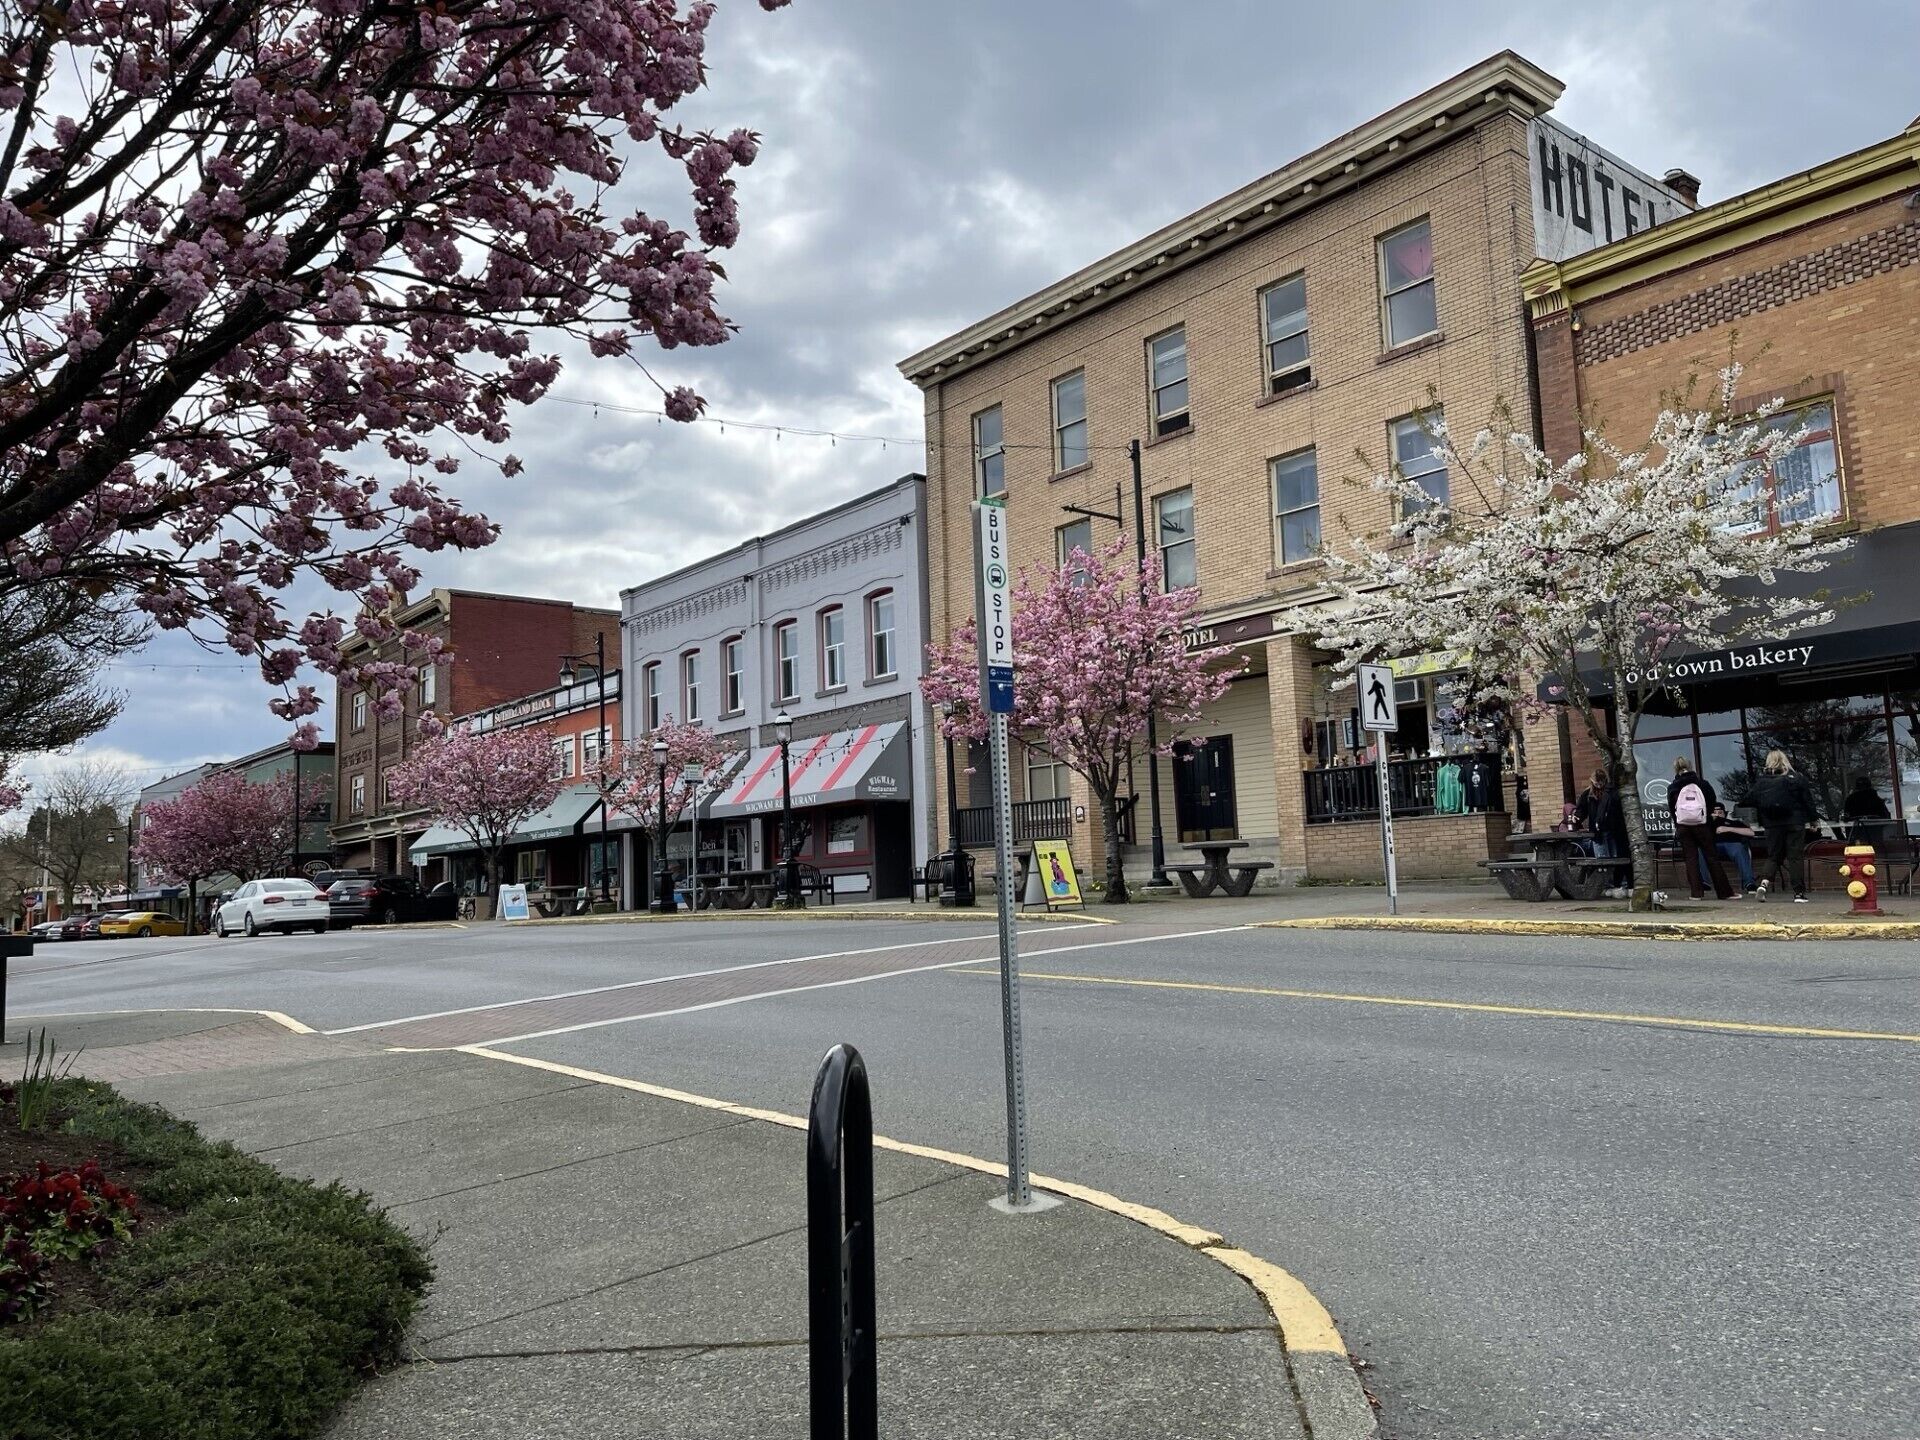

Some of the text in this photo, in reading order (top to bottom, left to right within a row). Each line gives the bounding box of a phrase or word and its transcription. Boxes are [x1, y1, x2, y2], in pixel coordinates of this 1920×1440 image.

[989, 514, 999, 559] BUS
[993, 593, 1004, 655] STOP
[1181, 628, 1219, 649] OTEL
[1729, 645, 1814, 671] bakery
[532, 697, 552, 712] BLOCK
[745, 794, 817, 813] WIGWAM REAURANT
[1382, 761, 1394, 855] CROSSWALK
[1641, 808, 1656, 820] ld
